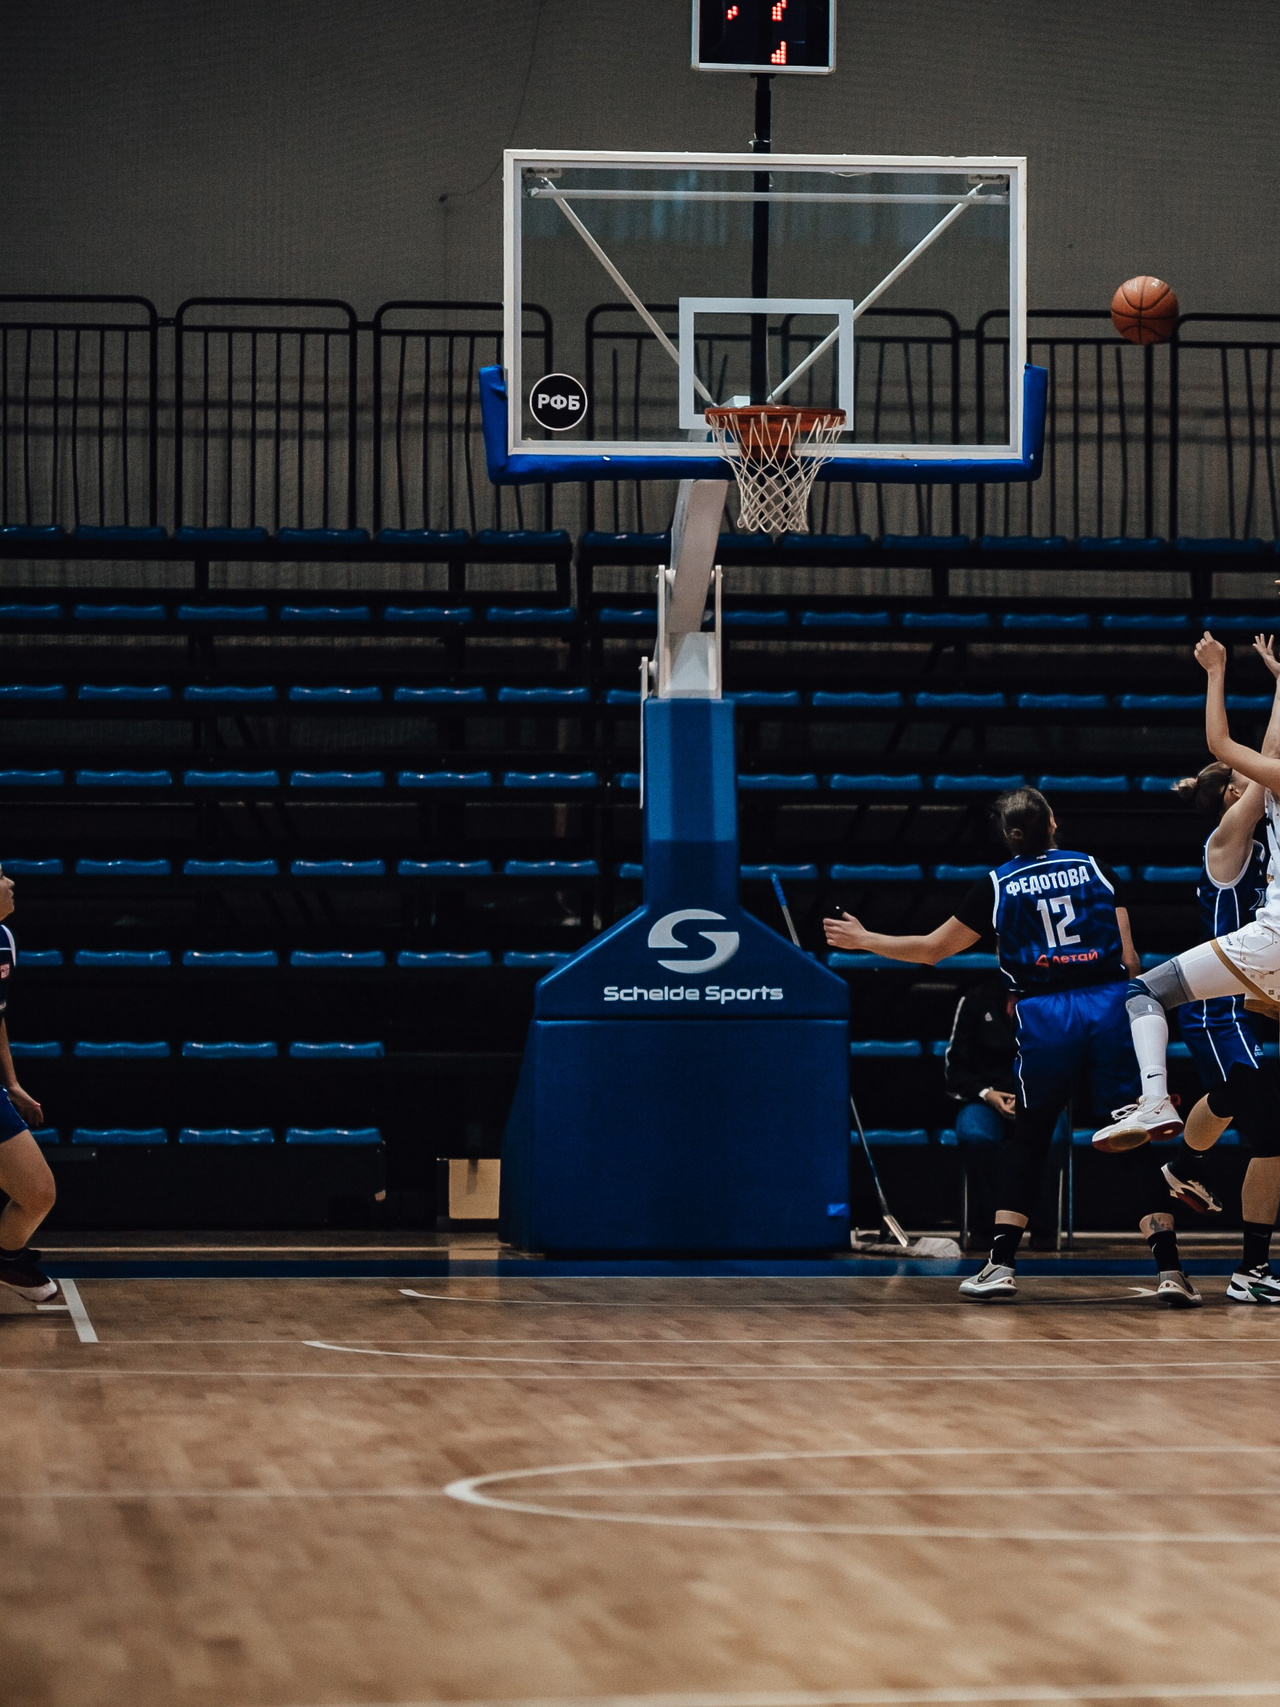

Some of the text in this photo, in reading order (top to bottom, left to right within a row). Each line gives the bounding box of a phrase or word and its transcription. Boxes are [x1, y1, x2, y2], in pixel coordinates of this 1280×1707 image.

[537, 393, 580, 411] РФБ
[1005, 865, 1091, 896] ФЕДОТОВА
[1036, 894, 1081, 949] 12
[603, 985, 784, 1005] Schelde Sports
